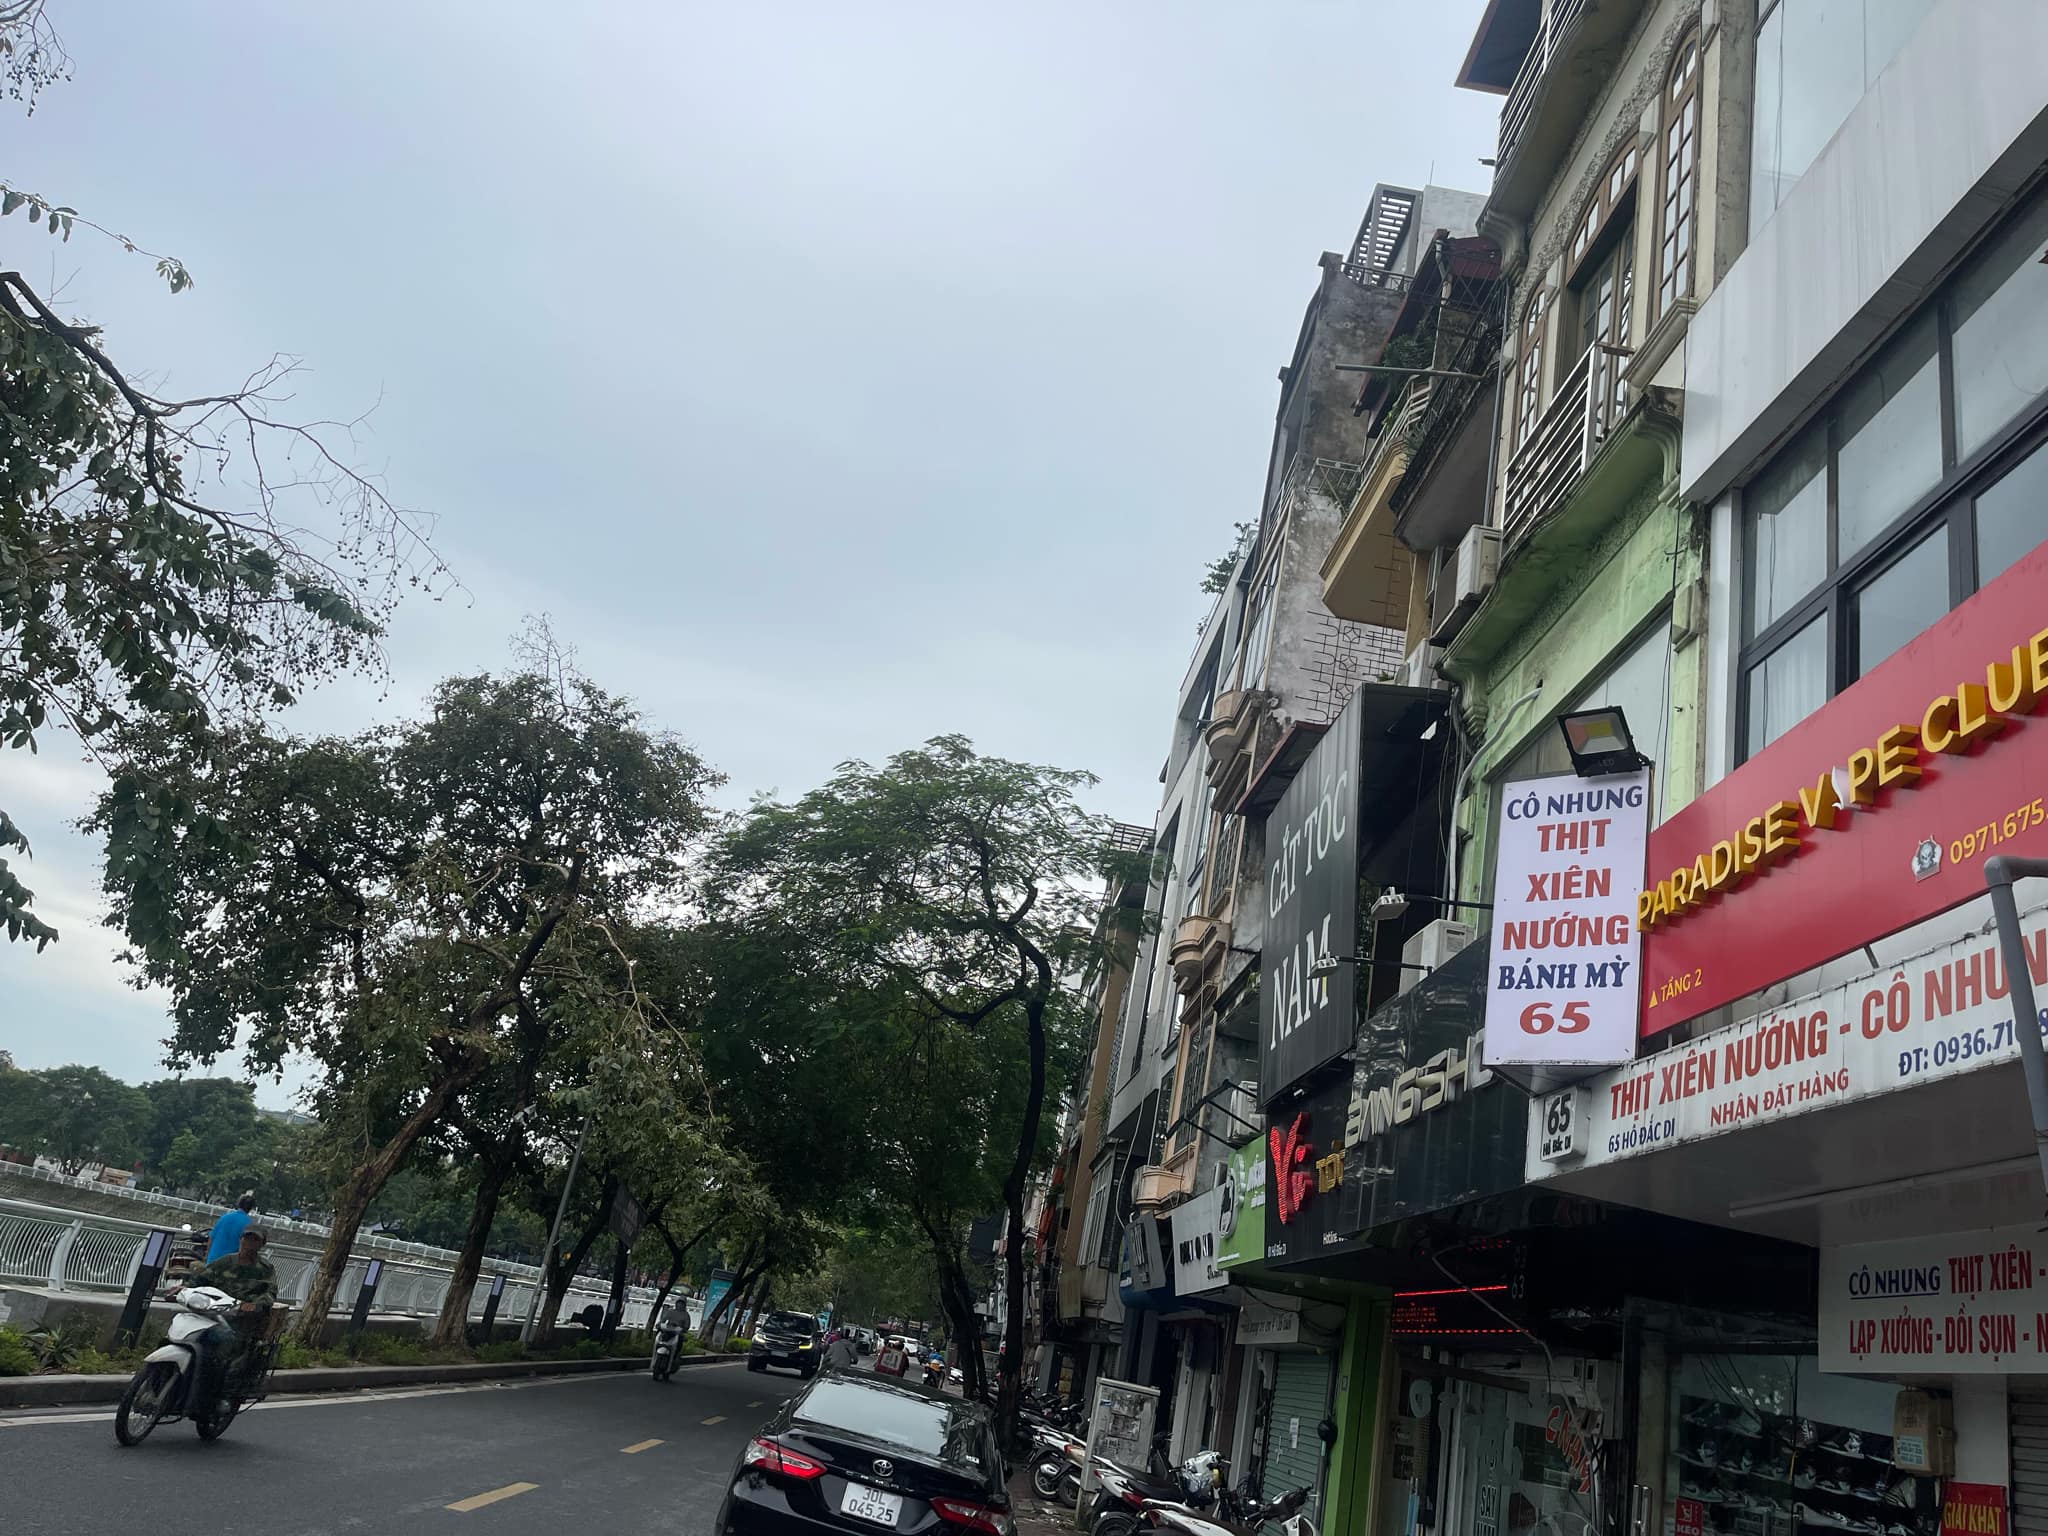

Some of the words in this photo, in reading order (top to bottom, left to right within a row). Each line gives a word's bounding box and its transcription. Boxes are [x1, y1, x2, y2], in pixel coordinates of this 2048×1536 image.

[1507, 791, 1540, 820] CÔ
[1547, 785, 1643, 816] NHUNG
[1269, 823, 1301, 919] CẮT
[1303, 770, 1348, 877] TÓC
[1537, 818, 1611, 855] THỊT
[1525, 864, 1611, 902] XIÊN
[1637, 801, 1794, 931] PARADISE
[1502, 911, 1629, 950] NƯỚNG
[1270, 913, 1331, 1050] NAM
[1497, 957, 1578, 990] BÁNH
[1584, 954, 1630, 988] MỲ
[1694, 968, 1702, 987] 2
[1519, 1001, 1591, 1035] 65
[1861, 971, 1911, 1040] CÔ
[1610, 1071, 1655, 1120] THỊT
[1658, 1049, 1717, 1105] XIÊN
[1724, 1010, 1828, 1084] NƯỚNG
[1547, 1093, 1571, 1135] 65
[1710, 1093, 1759, 1127] NHẬN
[1763, 1082, 1795, 1113] ĐẶT
[1798, 1068, 1849, 1102] HÀNG
[1608, 1134, 1620, 1153] 65
[1664, 1118, 1675, 1138] DI
[1849, 1264, 1870, 1295] CÔ
[1875, 1266, 1940, 1294] NHUNG
[1948, 1254, 1983, 1300] THỊT
[1989, 1243, 2032, 1291] XIÊN
[1850, 1319, 1876, 1361] LẠP
[1880, 1305, 1933, 1354] XƯỞNG
[1979, 1314, 2016, 1362] SỤN
[848, 1499, 894, 1522] 045.25
[862, 1487, 886, 1506] 30L
[1943, 1492, 1967, 1530] GIẢI
[1968, 1496, 2001, 1535] KHÁT
